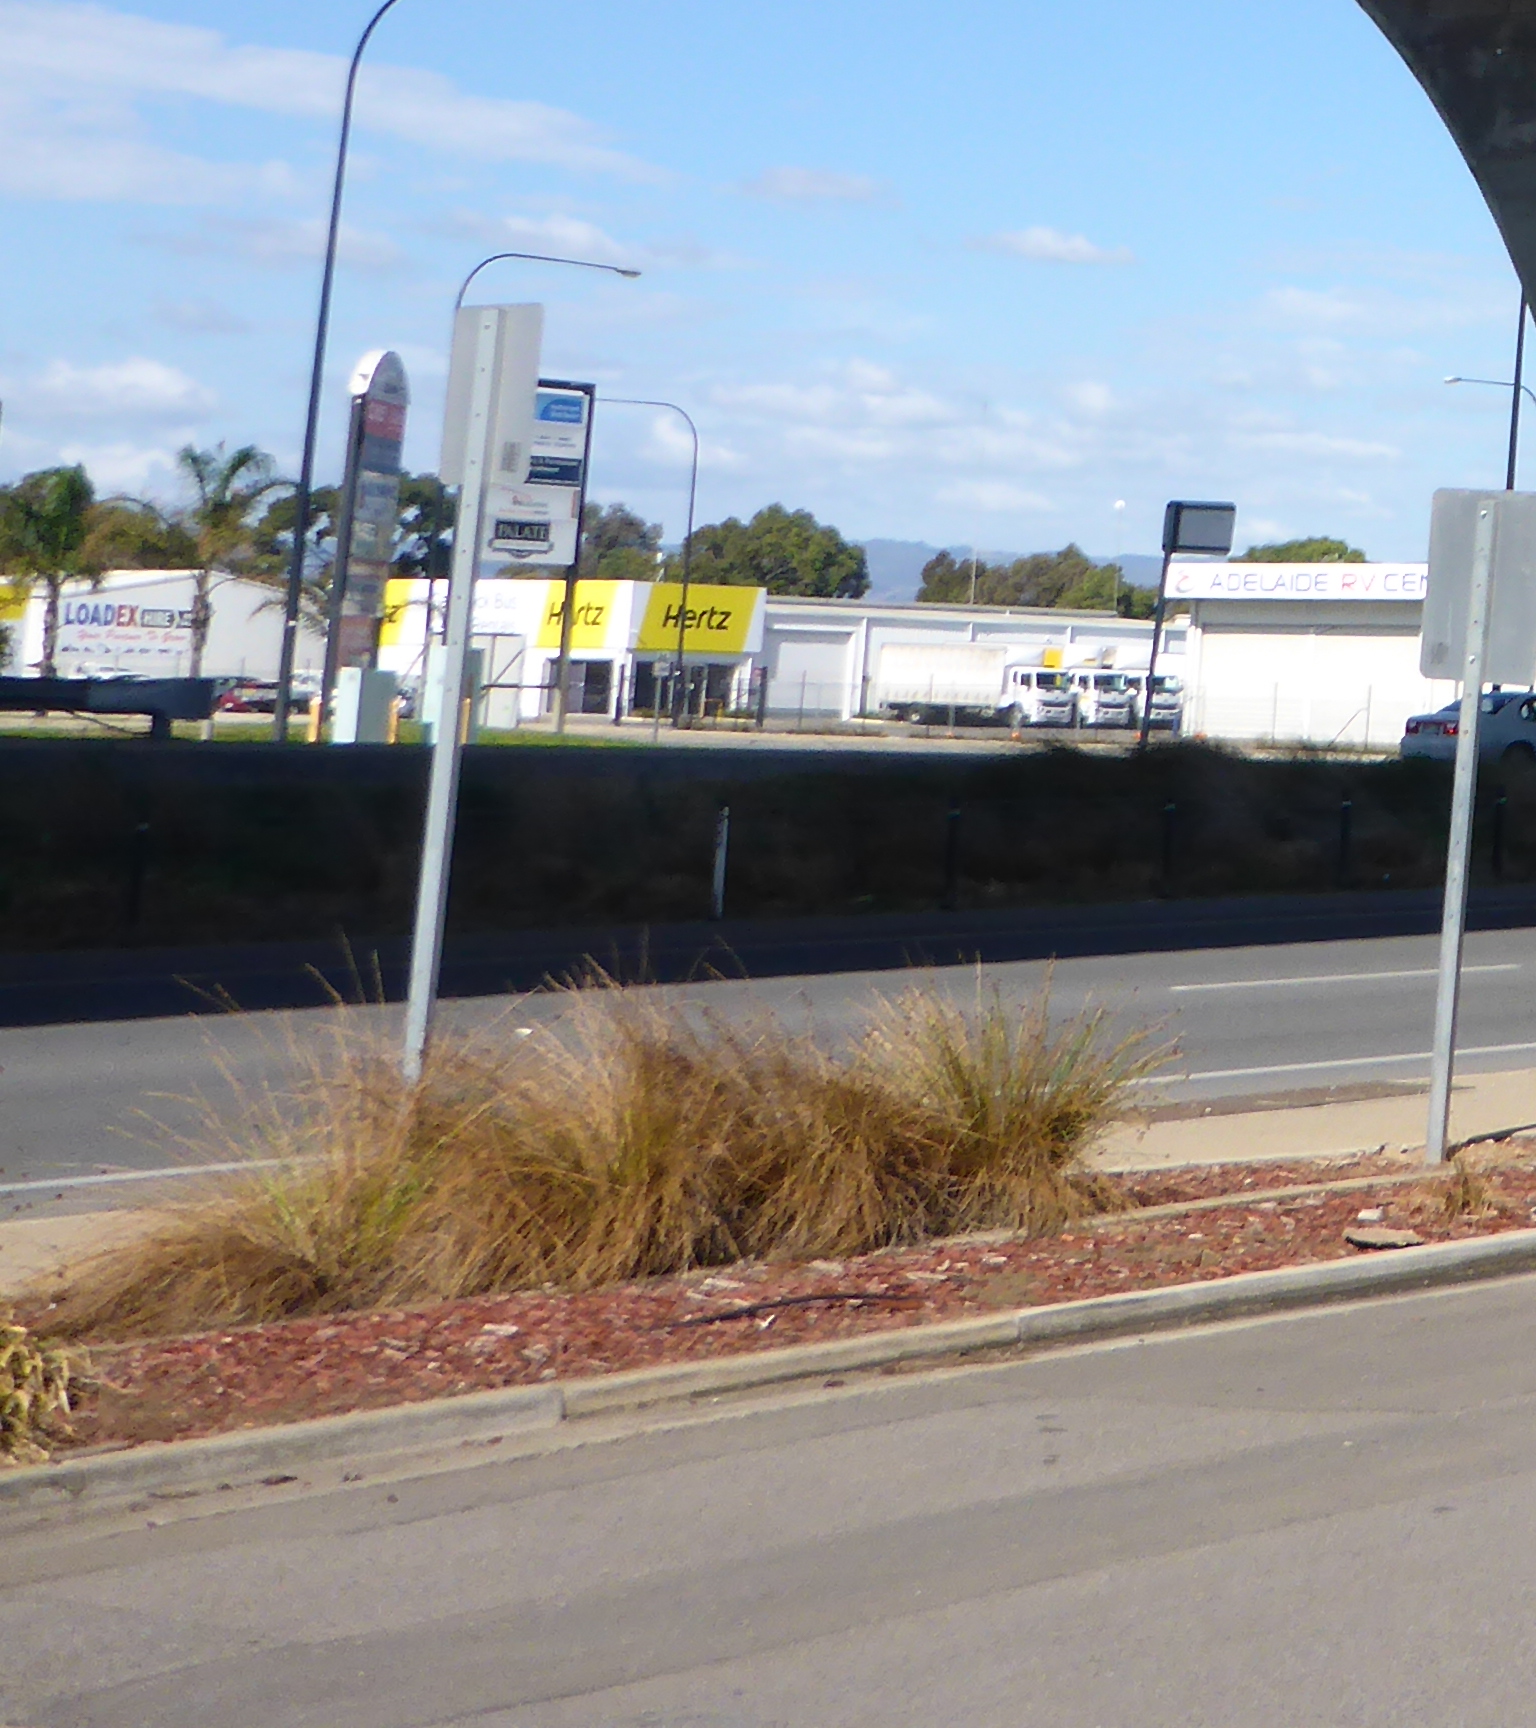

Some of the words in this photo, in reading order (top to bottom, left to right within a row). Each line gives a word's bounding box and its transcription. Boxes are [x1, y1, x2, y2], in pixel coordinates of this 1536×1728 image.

[1209, 573, 1328, 591] ADELAIDE
[1341, 573, 1376, 591] RV
[1383, 573, 1428, 591] CEN
[64, 602, 139, 627] LOADEX
[547, 602, 604, 625] Hrtz
[662, 604, 732, 630] Hertz
